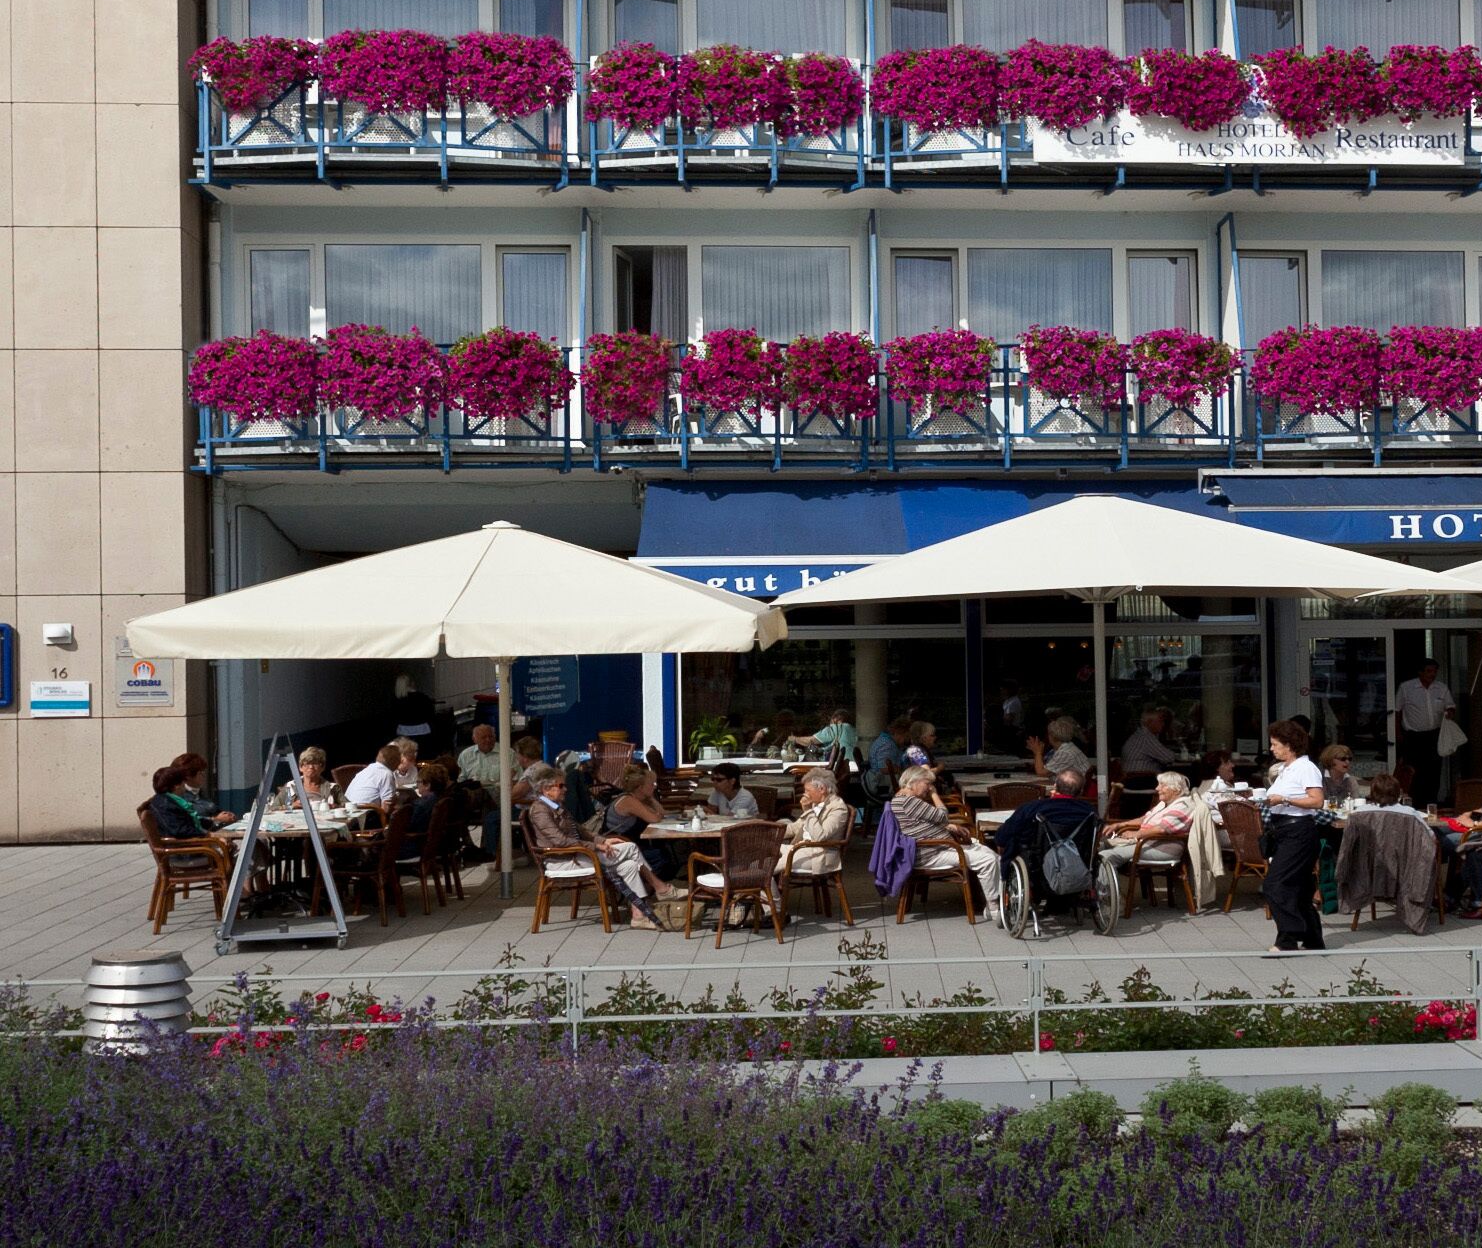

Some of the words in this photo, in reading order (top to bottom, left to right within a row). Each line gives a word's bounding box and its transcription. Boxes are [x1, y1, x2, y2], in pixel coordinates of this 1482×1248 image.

[1066, 125, 1136, 146] Cafe
[1217, 123, 1286, 138] HOTEL
[1336, 128, 1459, 149] Restaurant
[1178, 143, 1234, 157] HAUS
[1241, 143, 1325, 158] MORJAN
[51, 667, 69, 679] 16
